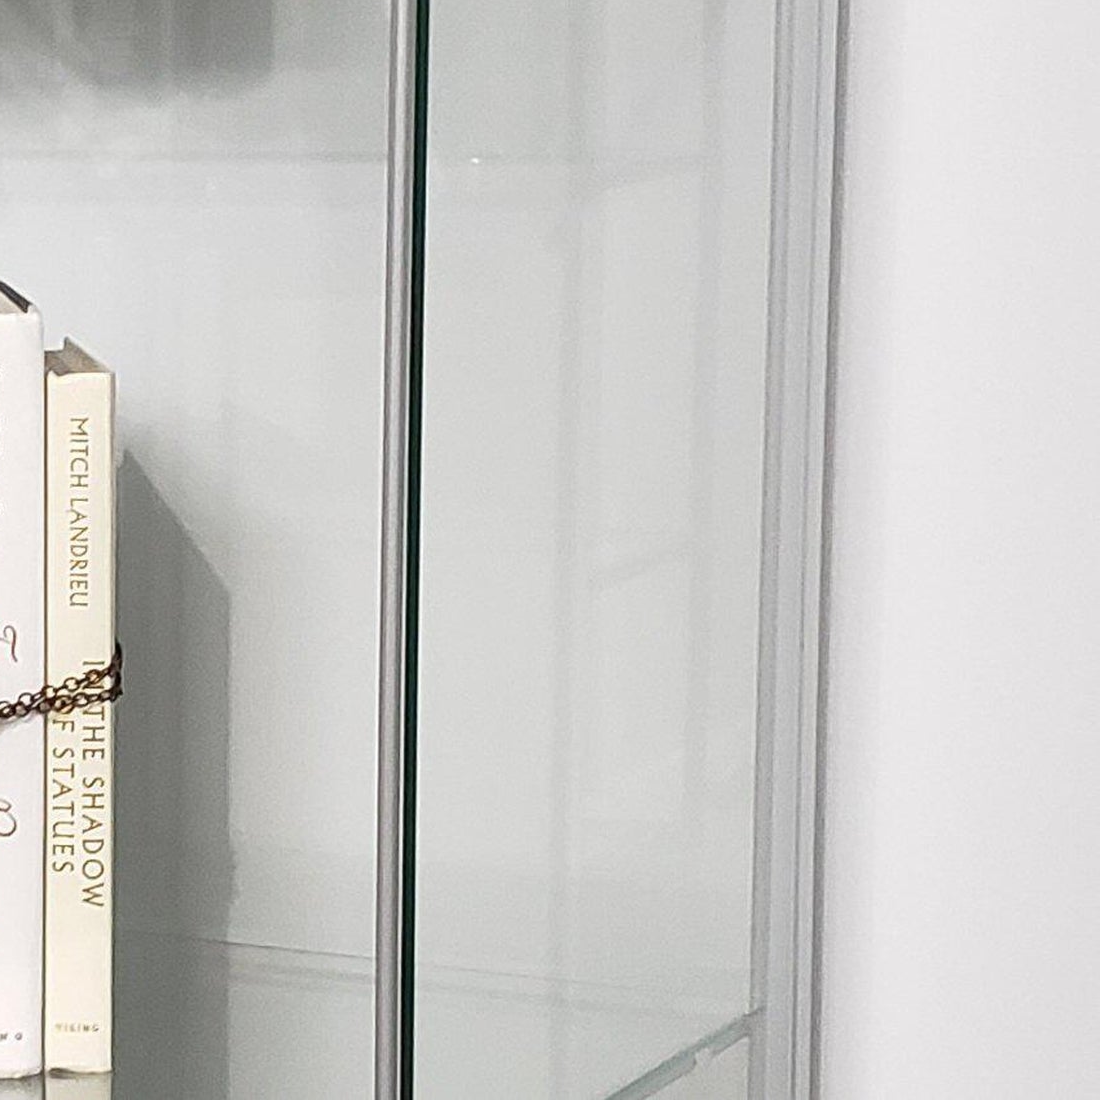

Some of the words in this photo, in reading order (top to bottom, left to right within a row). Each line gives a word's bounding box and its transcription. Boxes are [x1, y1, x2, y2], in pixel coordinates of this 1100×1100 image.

[69, 416, 90, 489] MITCH
[68, 498, 90, 608] LANDRIEU
[82, 704, 106, 761] THE
[52, 747, 76, 874] STATUES
[82, 776, 106, 908] SHADOW
[54, 1023, 100, 1033] VIKING
